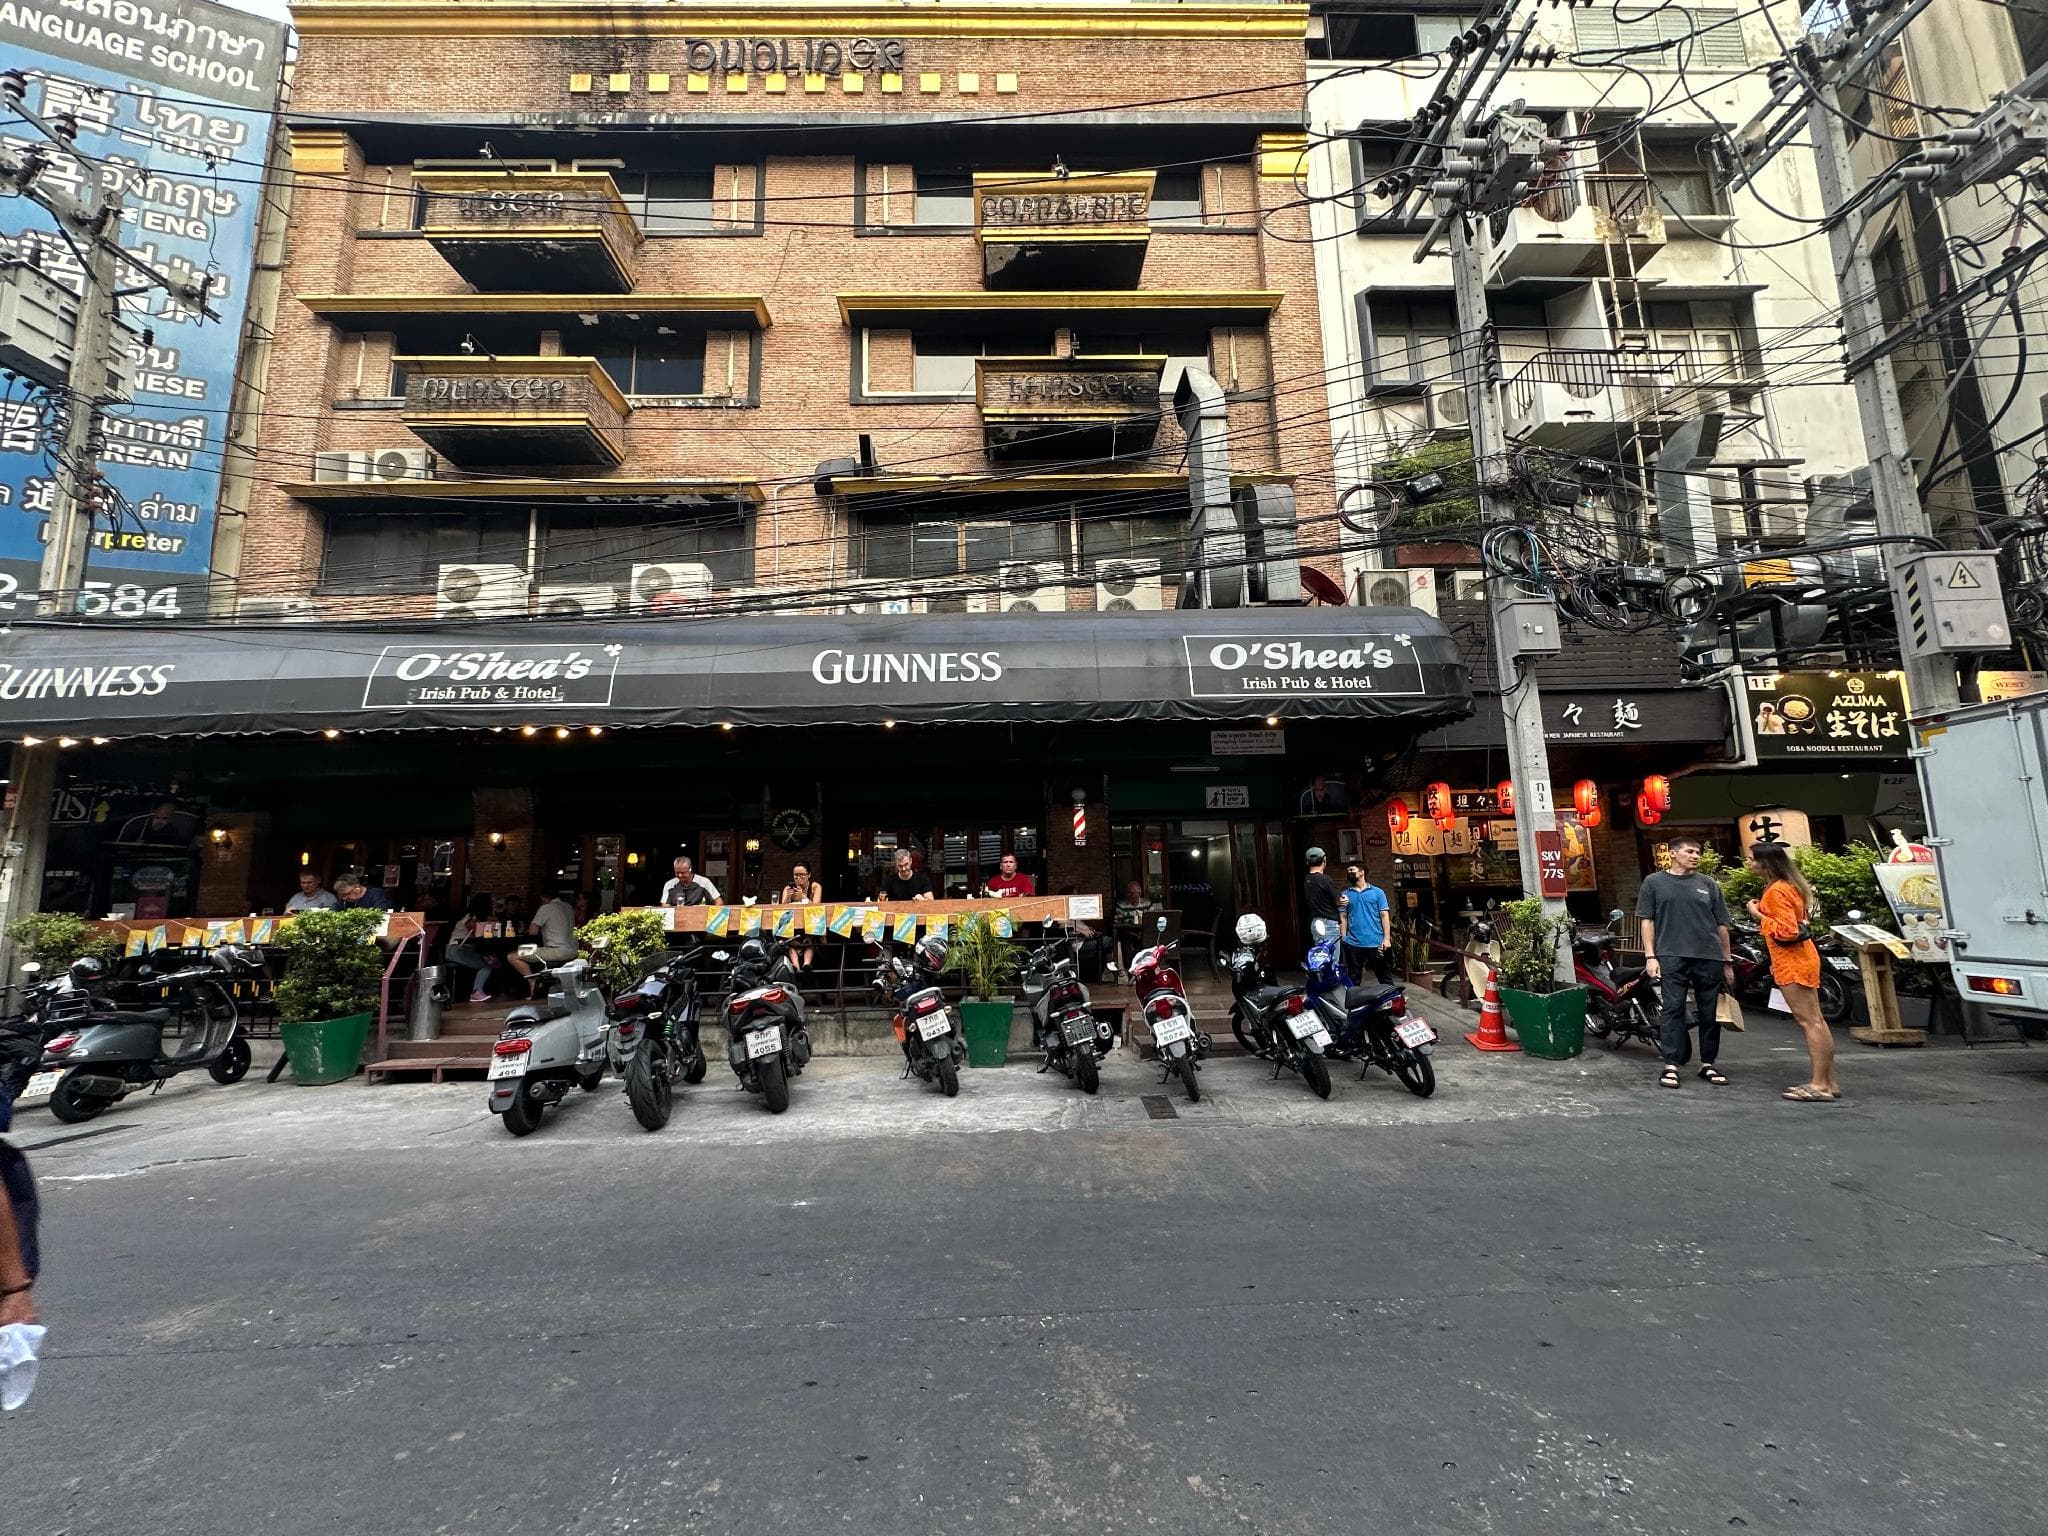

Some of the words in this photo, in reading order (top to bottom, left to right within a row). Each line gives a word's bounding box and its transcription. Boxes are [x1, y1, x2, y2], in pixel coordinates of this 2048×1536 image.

[150, 45, 262, 92] SCHOOL
[128, 82, 247, 145] ไทย
[144, 212, 208, 240] ENG
[134, 372, 204, 398] NESE
[97, 442, 189, 470] REAN
[140, 494, 196, 523] ล่าม
[396, 651, 594, 681] O'Shea's
[812, 649, 1003, 685] GUINNESS
[1209, 641, 1394, 670] O'Shea's
[419, 686, 456, 700] Irish
[460, 686, 491, 700] Pub
[495, 687, 509, 700] &
[513, 686, 556, 700] Hotel
[1242, 677, 1277, 689] Irish
[1280, 677, 1309, 689] Pub
[1313, 677, 1328, 689] &
[1332, 676, 1372, 689] Hotel
[1832, 695, 1887, 708] AZUMA
[1825, 711, 1900, 739] 生そば
[1837, 744, 1883, 752] RESTAURANT
[1541, 851, 1561, 862] SKV
[1542, 868, 1565, 879] 77S
[754, 1043, 776, 1055] 4055
